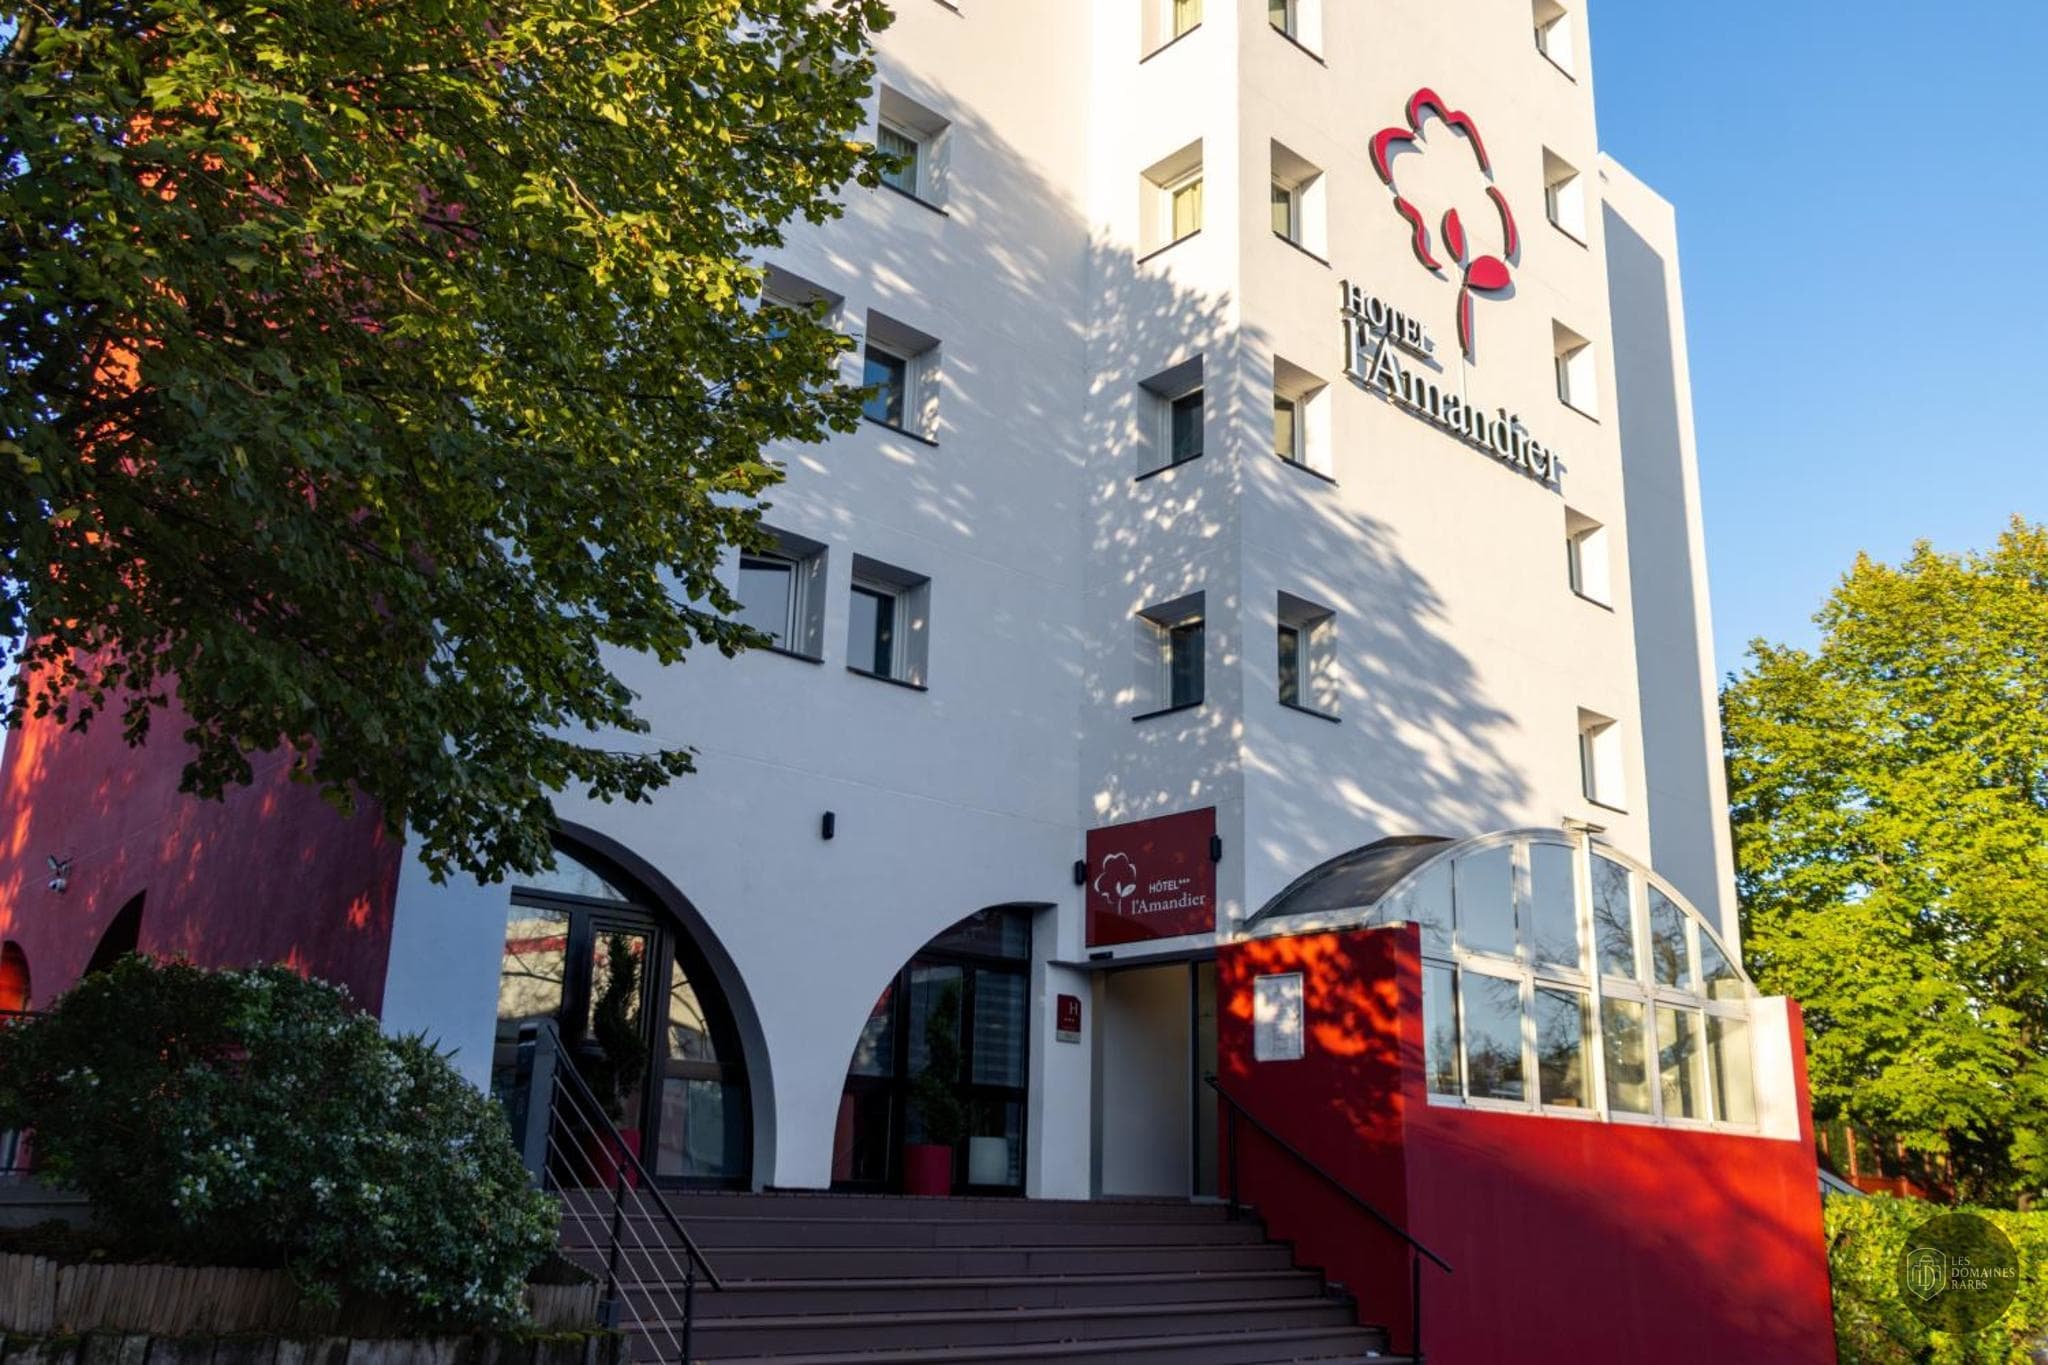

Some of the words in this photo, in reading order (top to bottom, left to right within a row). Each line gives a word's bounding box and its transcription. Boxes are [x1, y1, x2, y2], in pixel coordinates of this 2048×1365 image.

[1342, 317, 1563, 483] l'Amandier
[1132, 893, 1206, 915] l'Amandier
[1069, 1001, 1078, 1016] H
